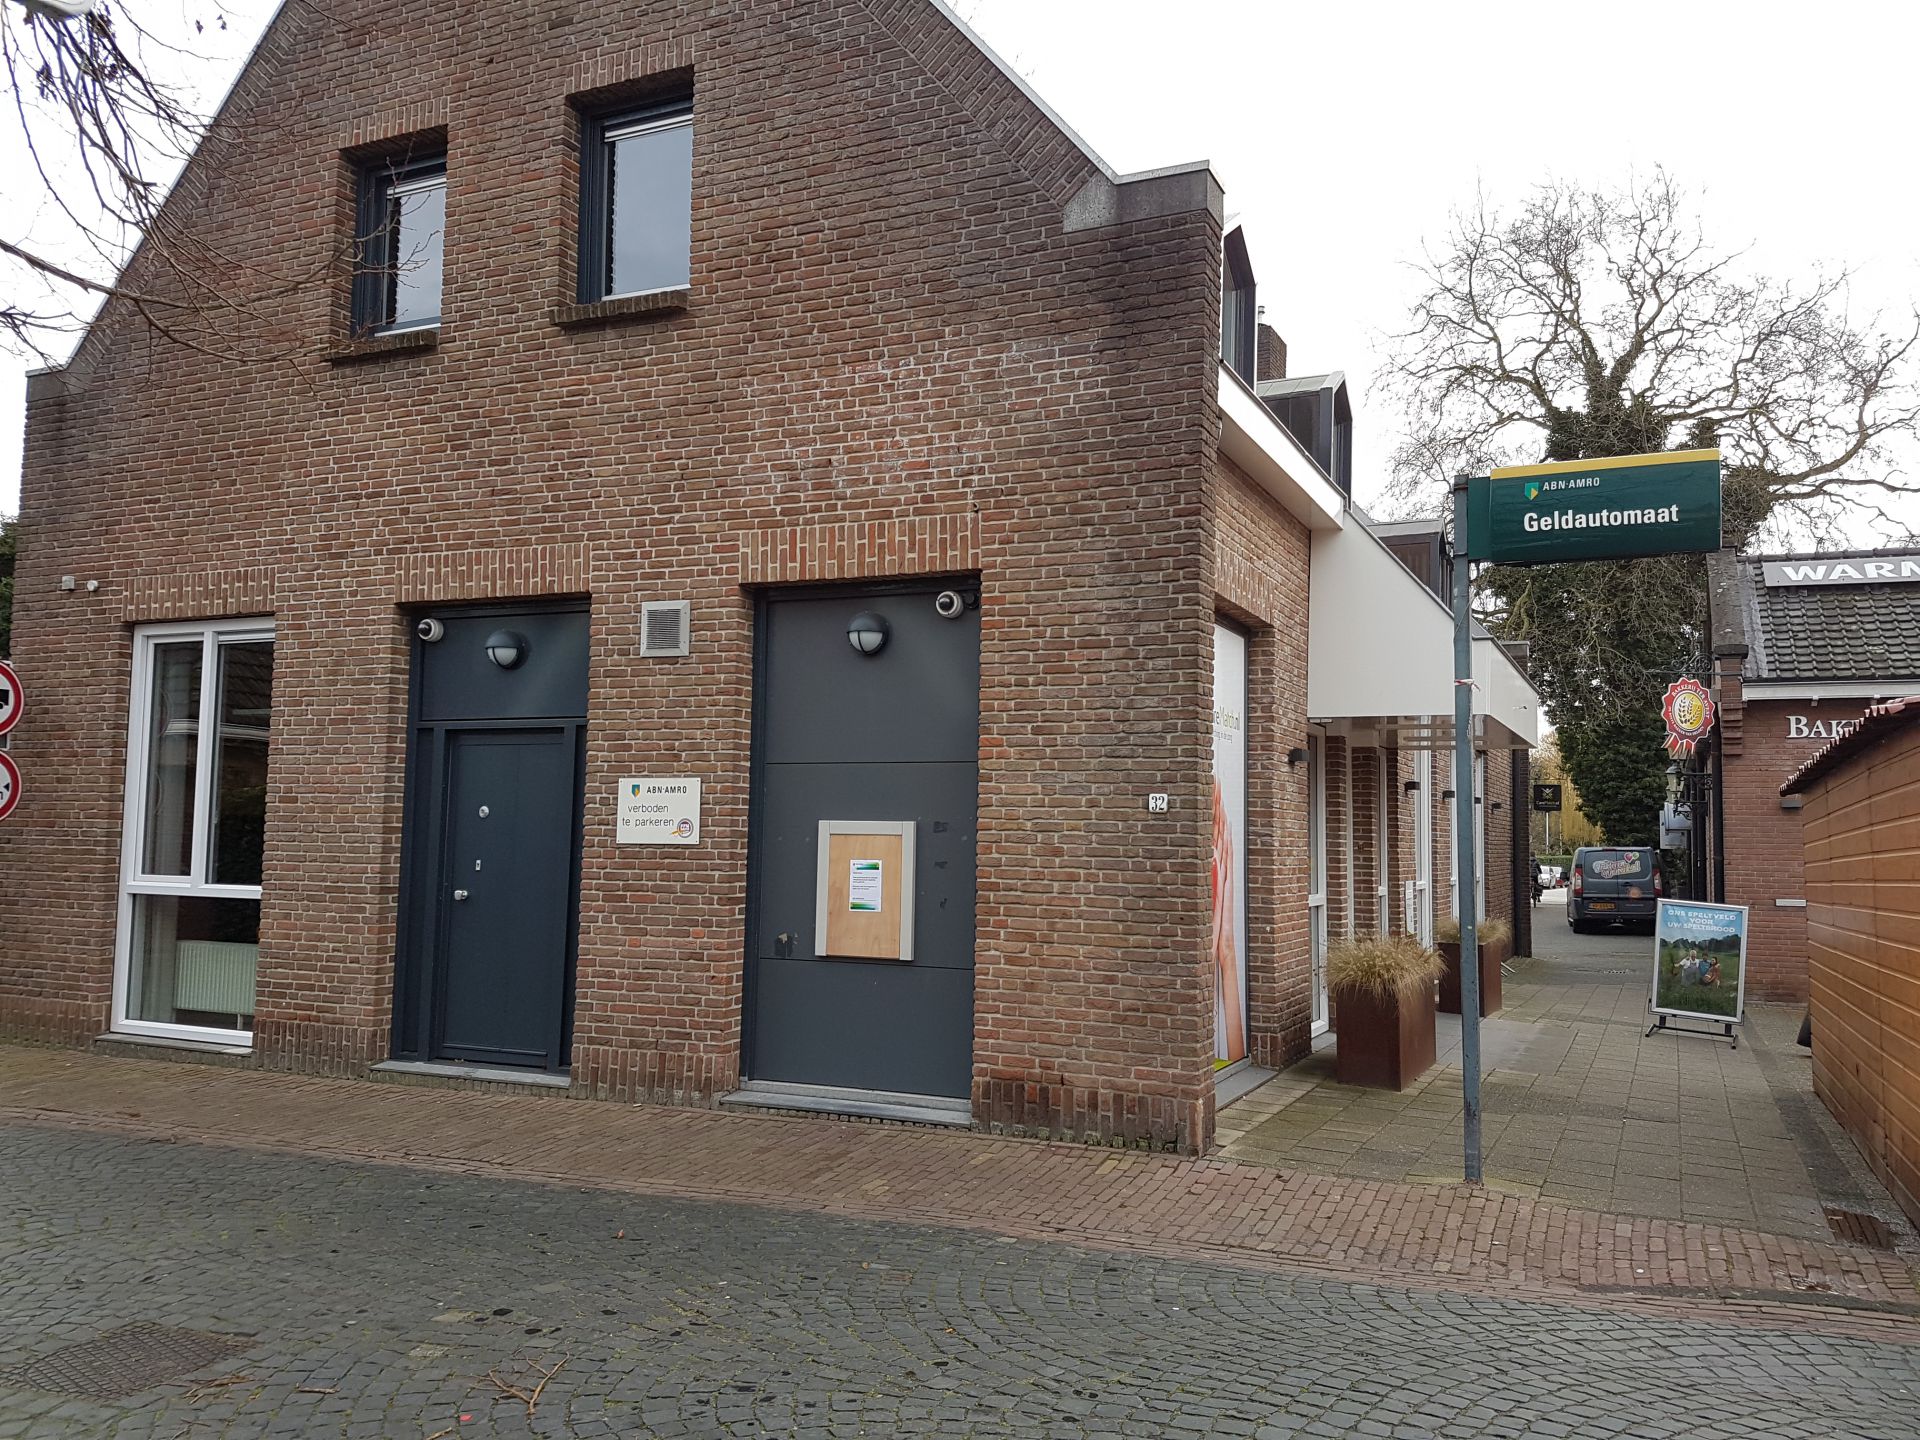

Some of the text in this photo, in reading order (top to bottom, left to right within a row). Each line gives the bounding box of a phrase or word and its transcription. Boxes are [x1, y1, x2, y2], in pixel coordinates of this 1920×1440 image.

[1523, 504, 1679, 532] Geldautomaat
[628, 803, 669, 813] verboden
[1151, 795, 1165, 811] 32
[622, 817, 675, 828] te parkeren
[1668, 909, 1686, 917] ONS
[1688, 917, 1714, 925] VOOR
[1667, 921, 1736, 933] UW SPELTBROOD
